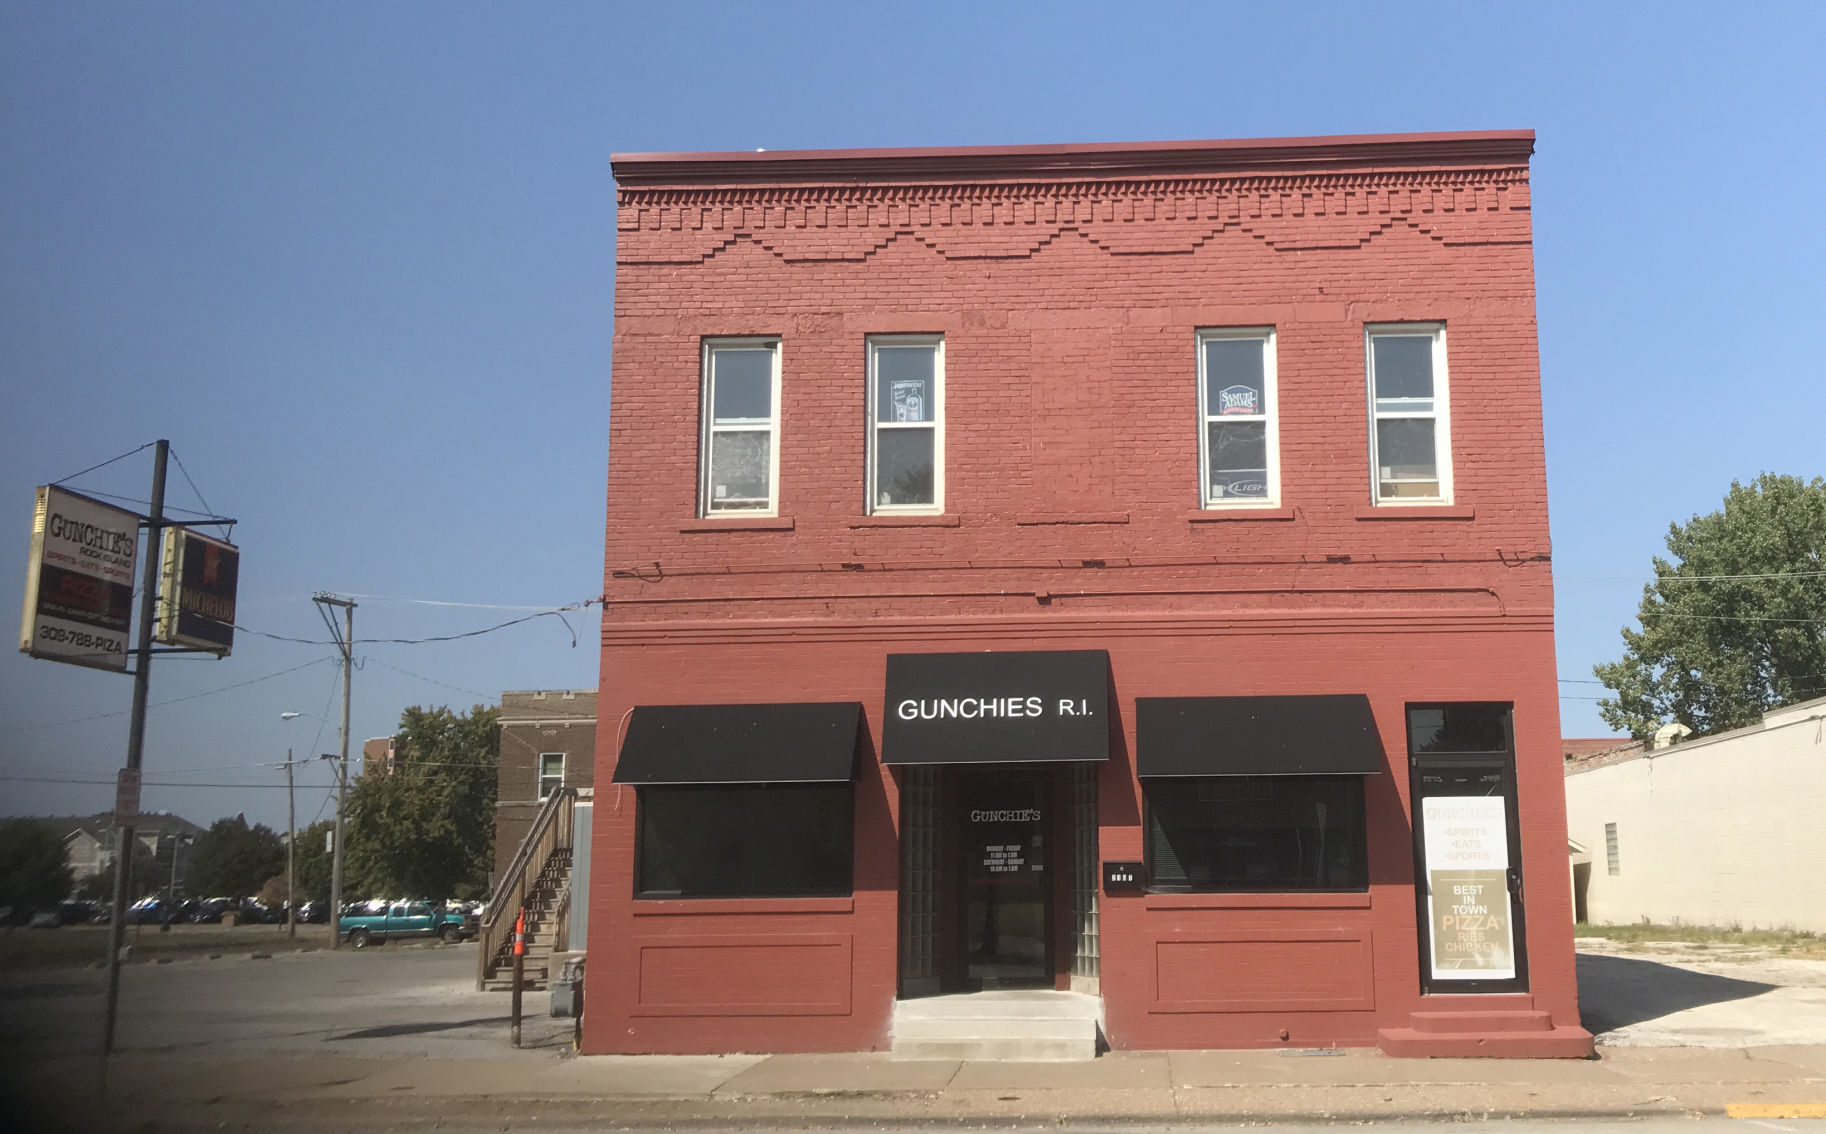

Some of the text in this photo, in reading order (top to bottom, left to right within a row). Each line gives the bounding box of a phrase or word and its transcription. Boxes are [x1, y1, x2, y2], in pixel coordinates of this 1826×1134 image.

[1222, 391, 1256, 402] SAMUEL
[1225, 398, 1253, 409] ADAMS
[50, 513, 134, 557] GUNCHIE'S
[79, 546, 103, 559] ROCK
[898, 696, 1093, 720] GUNCHIES R.I.
[971, 808, 1041, 822] GUNCHIE'S
[1453, 885, 1484, 895] BEST
[1463, 895, 1475, 904] IN
[1452, 905, 1487, 915] TOWN
[1442, 915, 1500, 930] PIZZA
[1457, 932, 1486, 942] RIBS
[1445, 942, 1499, 952] CHICKEN
